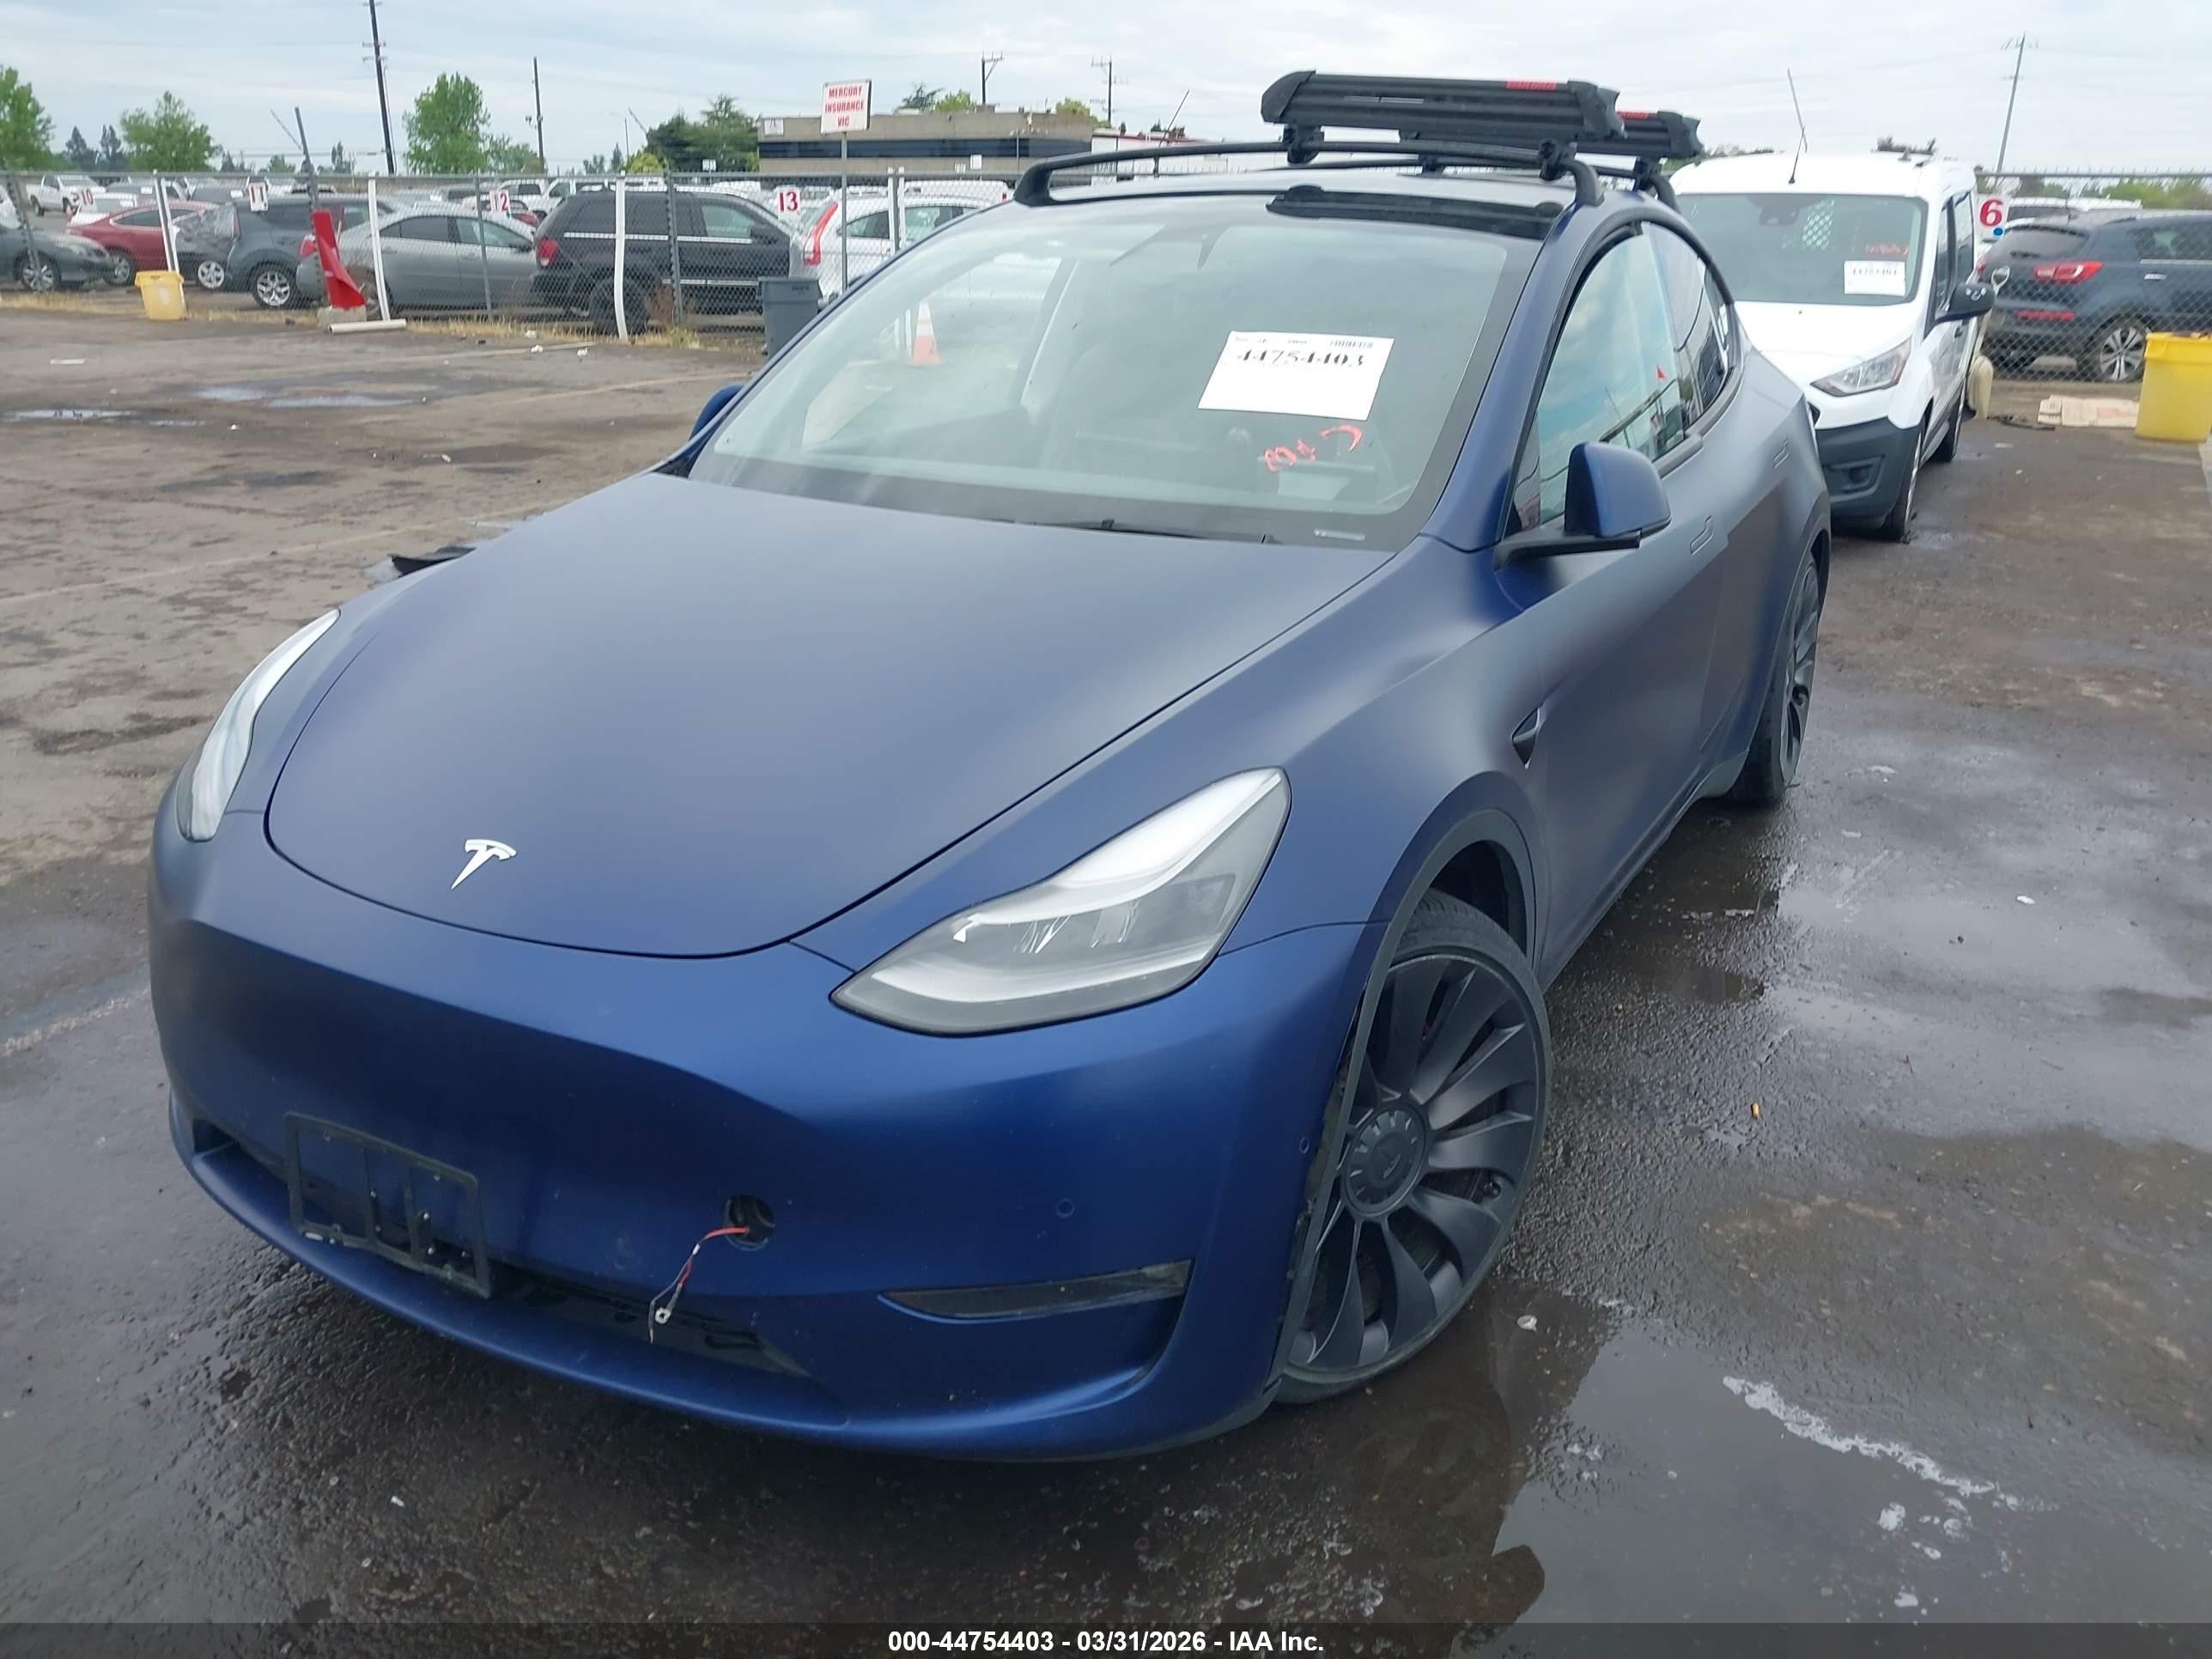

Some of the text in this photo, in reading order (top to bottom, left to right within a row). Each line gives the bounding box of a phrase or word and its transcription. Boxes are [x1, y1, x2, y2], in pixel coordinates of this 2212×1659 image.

[829, 85, 862, 98] MERCURY
[824, 100, 864, 113] INSURANCE
[837, 116, 849, 127] VIC
[81, 189, 94, 205] 10
[494, 192, 508, 212] 12
[779, 191, 799, 211] 13
[1979, 199, 2002, 227] 6
[1237, 349, 1364, 367] 44754403
